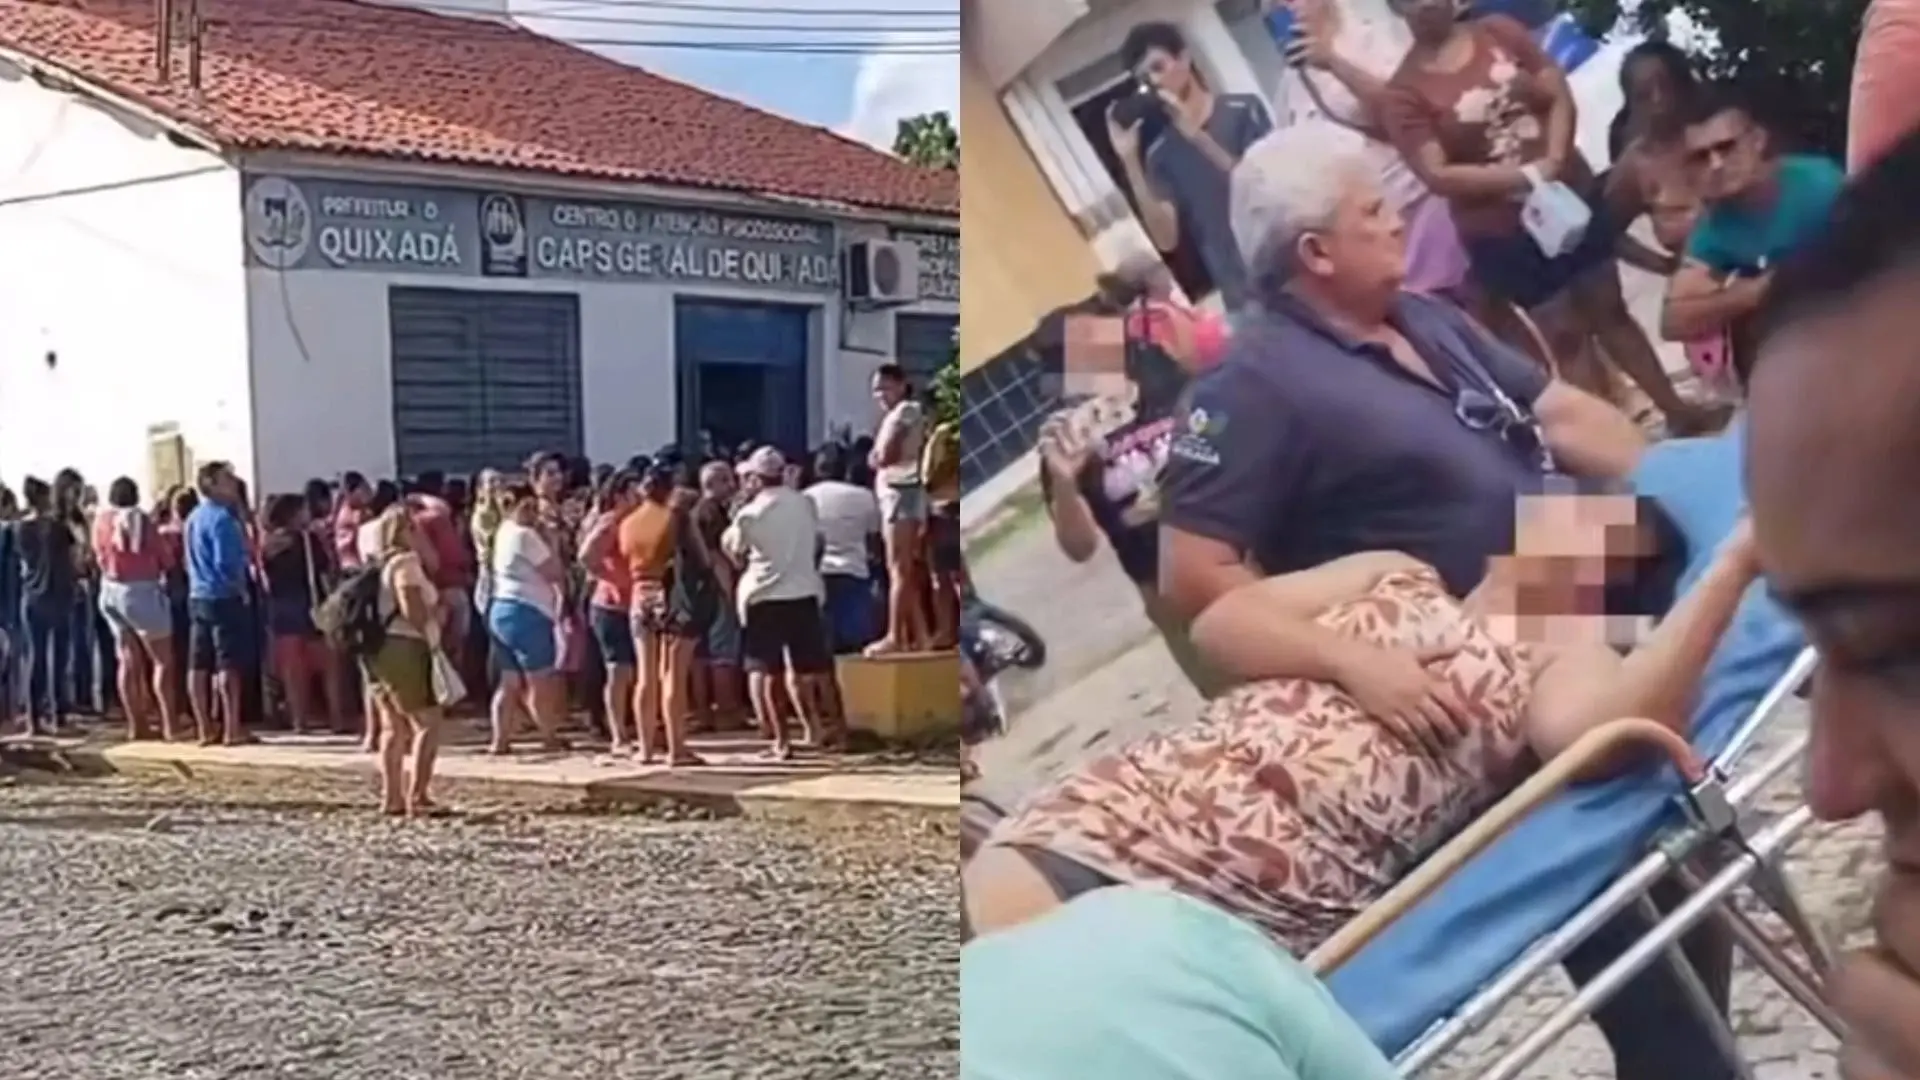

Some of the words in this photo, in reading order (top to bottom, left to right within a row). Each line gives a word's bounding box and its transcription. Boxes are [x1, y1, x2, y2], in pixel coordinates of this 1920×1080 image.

[322, 196, 410, 218] PREFEITUR
[319, 223, 462, 267] QUIXADÁ
[538, 236, 613, 273] CAPS
[708, 249, 739, 279] DE
